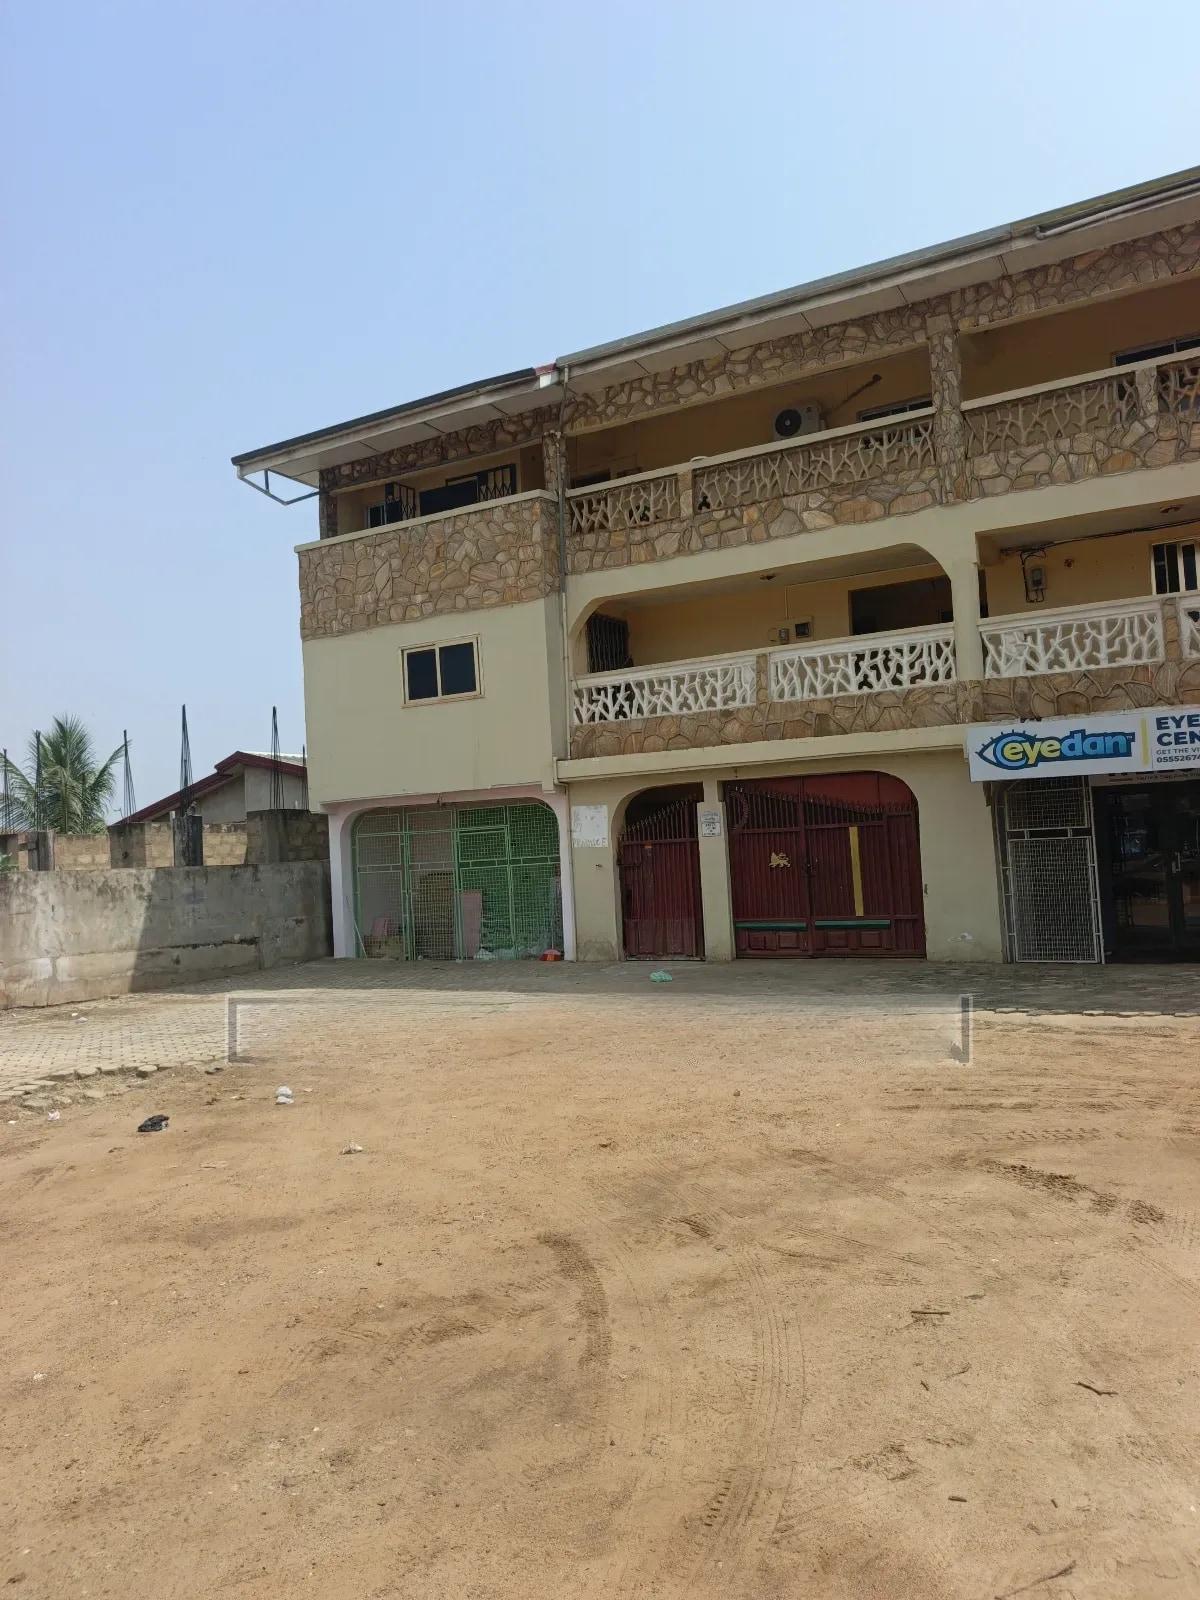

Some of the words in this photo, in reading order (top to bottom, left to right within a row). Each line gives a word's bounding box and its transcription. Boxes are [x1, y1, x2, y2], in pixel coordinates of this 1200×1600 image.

[1156, 714, 1200, 730] EYE
[1157, 731, 1200, 747] CEN
[1002, 732, 1128, 765] eyedan
